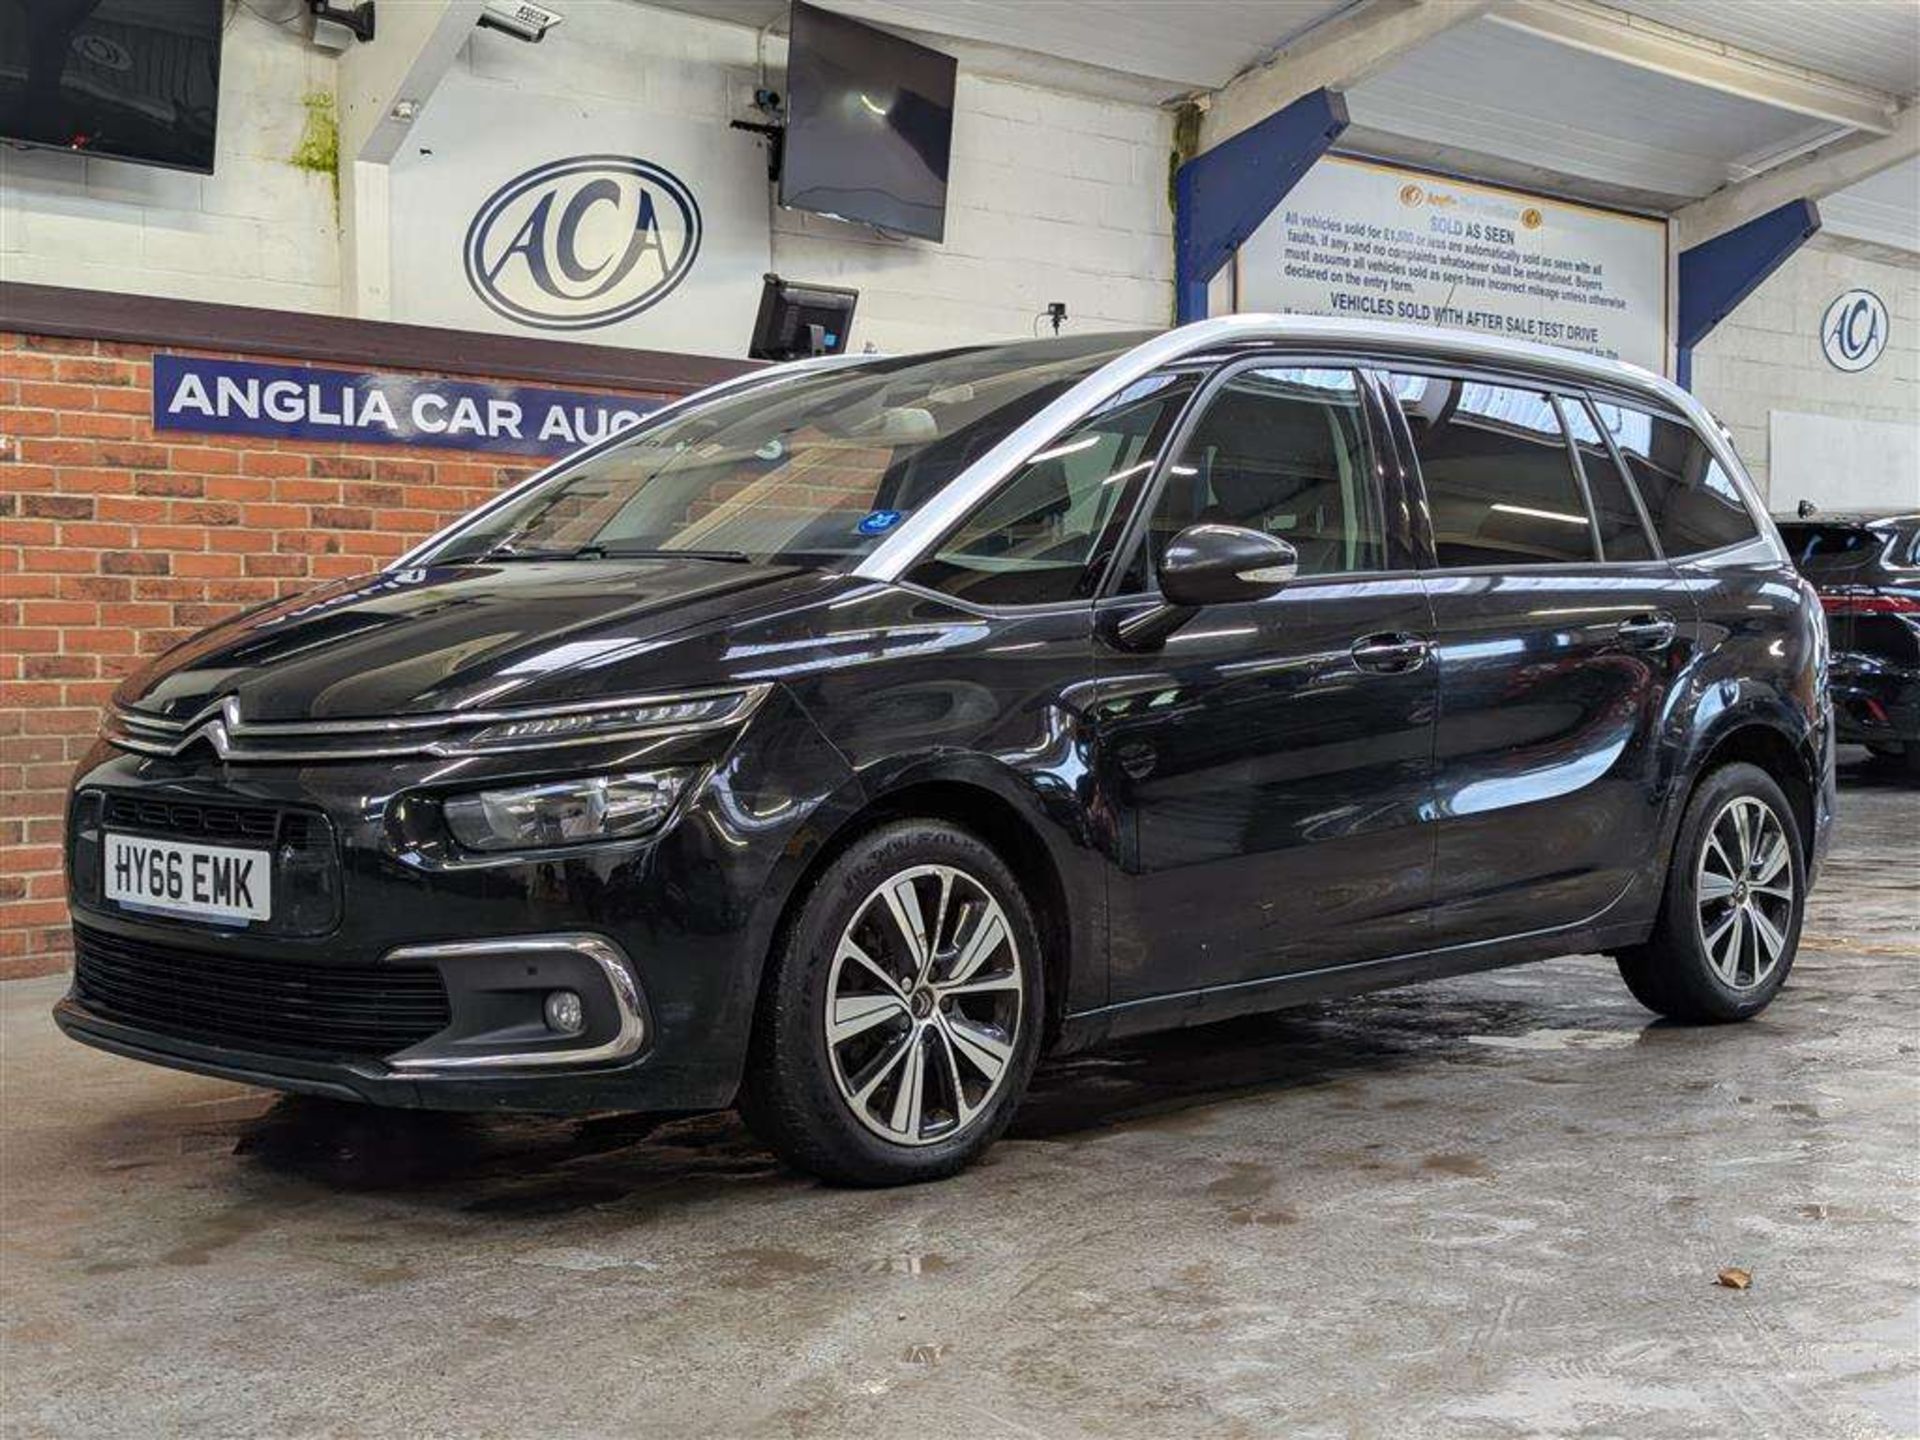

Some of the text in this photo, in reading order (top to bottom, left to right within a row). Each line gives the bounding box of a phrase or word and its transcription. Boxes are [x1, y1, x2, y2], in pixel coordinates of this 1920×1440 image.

[487, 178, 675, 300] ACA
[1285, 212, 1298, 224] All
[1301, 214, 1341, 232] vehicles
[1344, 223, 1365, 236] sold
[1367, 225, 1382, 239] for
[1449, 241, 1462, 252] are
[1465, 244, 1521, 265] automatically
[1522, 253, 1540, 266] sold
[1542, 258, 1552, 267] as
[1554, 259, 1573, 270] seen
[1575, 261, 1591, 274] with
[1593, 264, 1602, 275] all
[1430, 215, 1515, 245] SOLD AS SEEN
[1284, 263, 1415, 294] declared on the entry form.
[1284, 248, 1626, 310] must assume all vehicles sold as seen have incorrect mileage unless otherwise
[1321, 234, 1328, 246] if
[1331, 237, 1350, 253] any,
[1353, 241, 1371, 254] and
[1374, 245, 1386, 256] no
[1388, 246, 1437, 265] complaints
[1440, 255, 1490, 273] whatsoever
[1491, 261, 1511, 276] shall
[1513, 265, 1525, 277] be
[1576, 275, 1602, 291] Buyers
[1330, 291, 1394, 316] VEHICLES
[1397, 302, 1430, 321] SOLD
[1433, 306, 1463, 325] WITH
[1466, 309, 1503, 330] AFTER
[1506, 316, 1535, 335] SALE
[1537, 320, 1566, 338] TEST
[1567, 325, 1598, 343] DRIVE
[1825, 298, 1881, 361] ACA
[168, 373, 650, 447] ANGLIA CAR AUC
[115, 844, 253, 908] HY66 EMK
